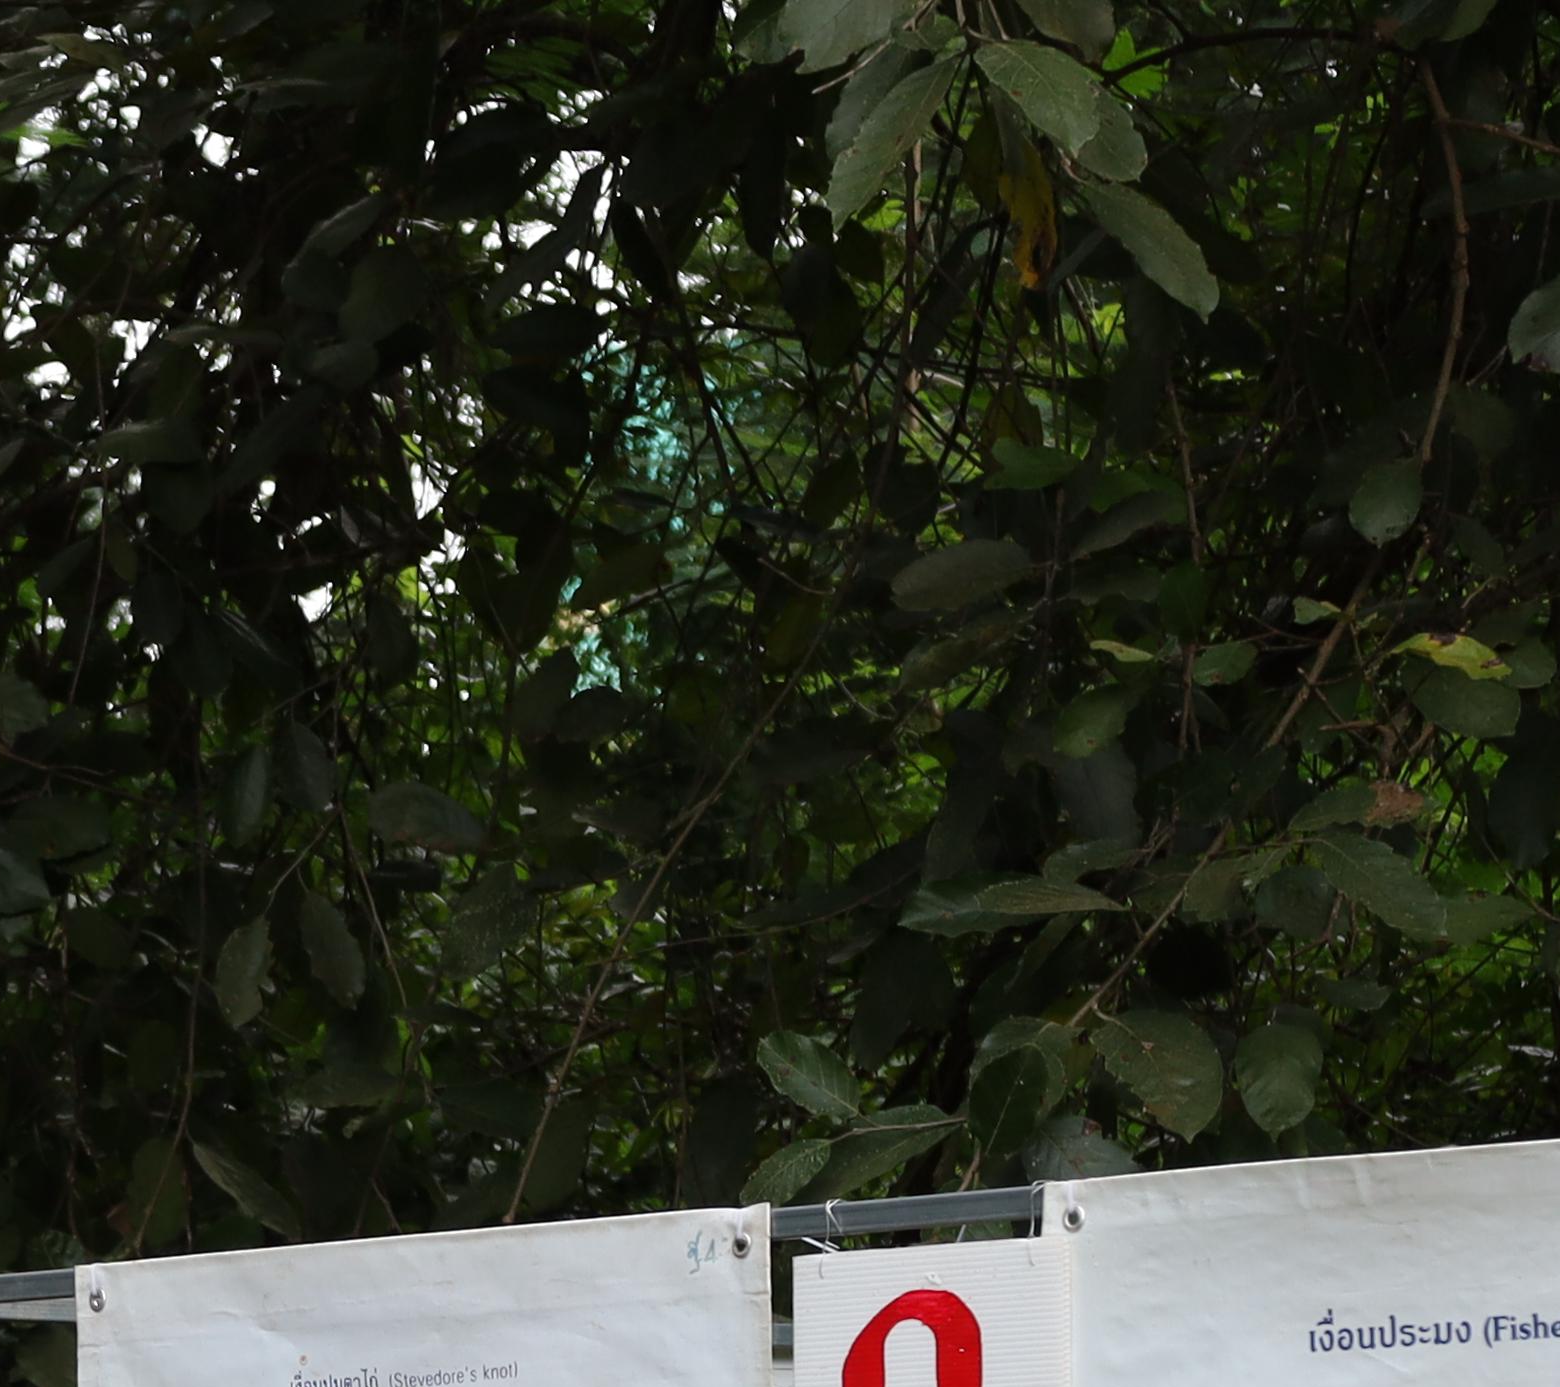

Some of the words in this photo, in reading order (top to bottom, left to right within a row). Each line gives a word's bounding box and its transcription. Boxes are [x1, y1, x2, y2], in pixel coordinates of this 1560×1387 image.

[1309, 1308, 1472, 1352] เงื่อนประมง
[482, 1360, 519, 1381] knot)
